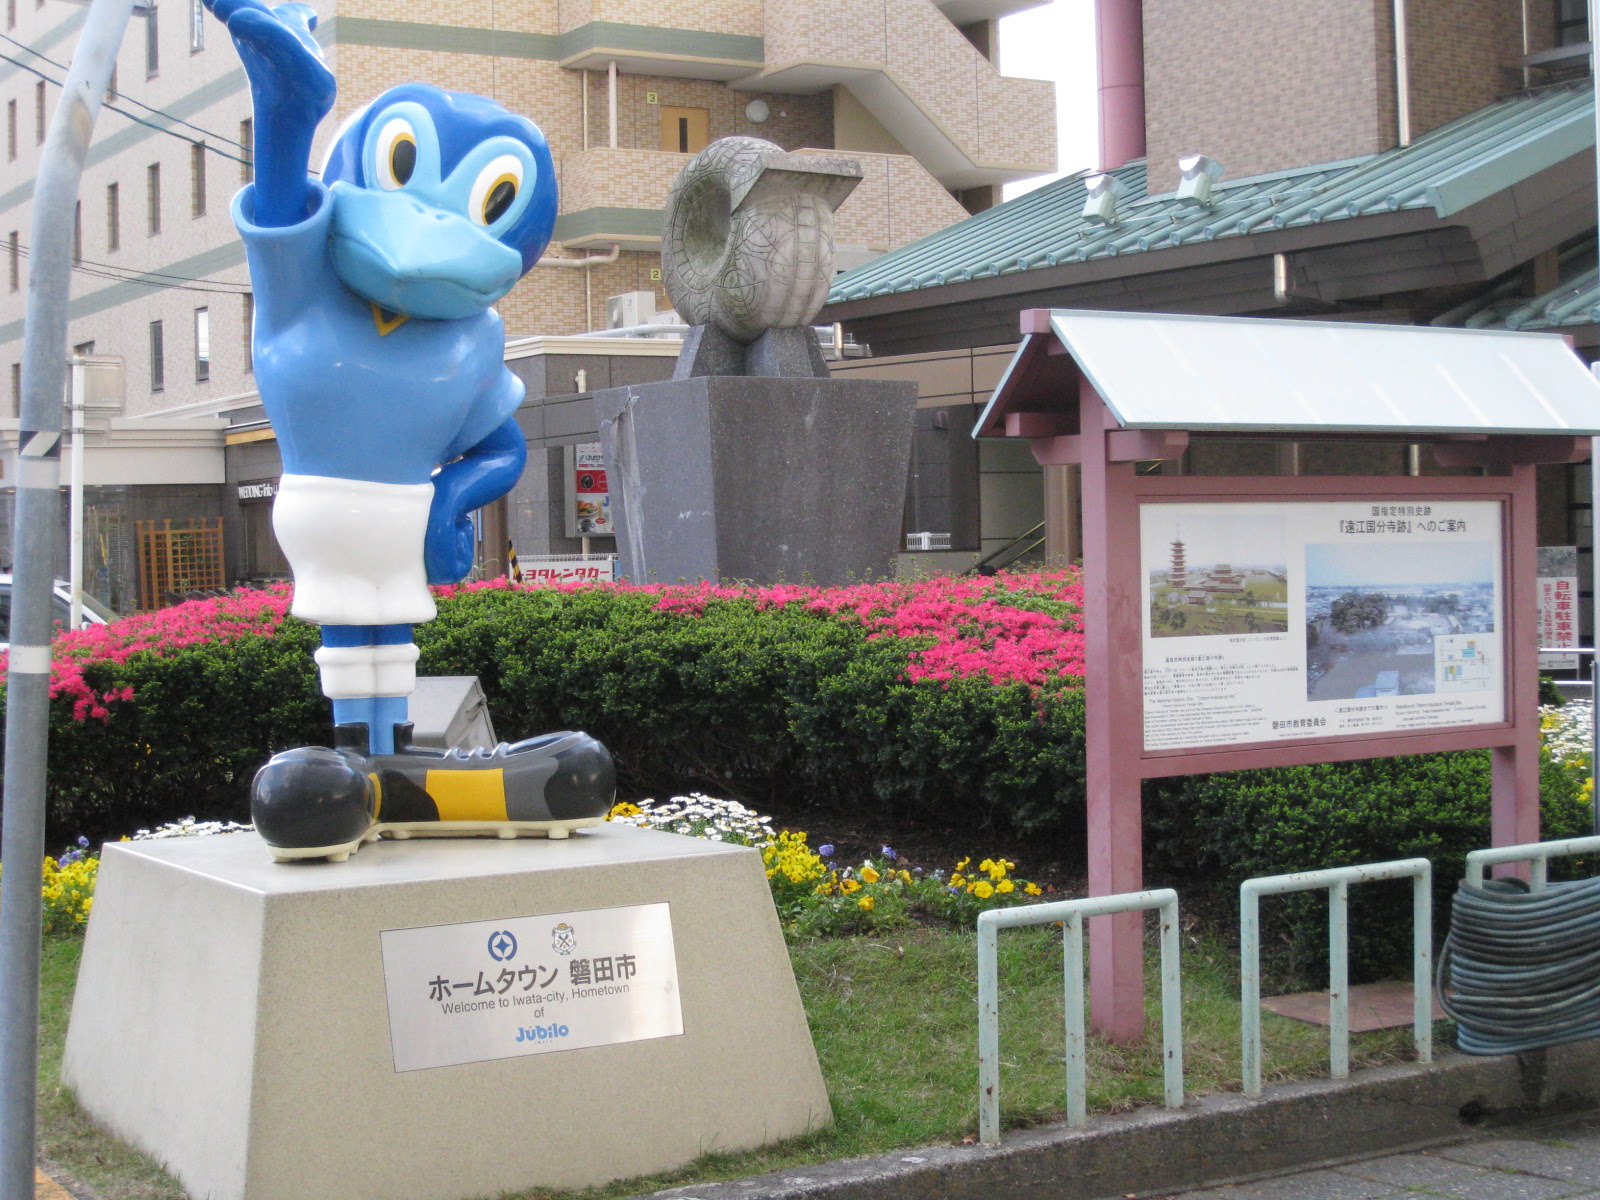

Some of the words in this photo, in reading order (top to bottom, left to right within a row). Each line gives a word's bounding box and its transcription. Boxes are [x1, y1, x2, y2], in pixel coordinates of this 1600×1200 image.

[513, 567, 610, 580] ヨタレンタカー
[429, 965, 559, 1002] ホームタウン
[569, 953, 637, 986] 磐田市
[441, 1001, 496, 1014] Welcome
[499, 997, 510, 1008] to
[512, 990, 569, 1007] Iwata-city,
[571, 983, 630, 999] Hometown
[534, 1006, 545, 1018] of
